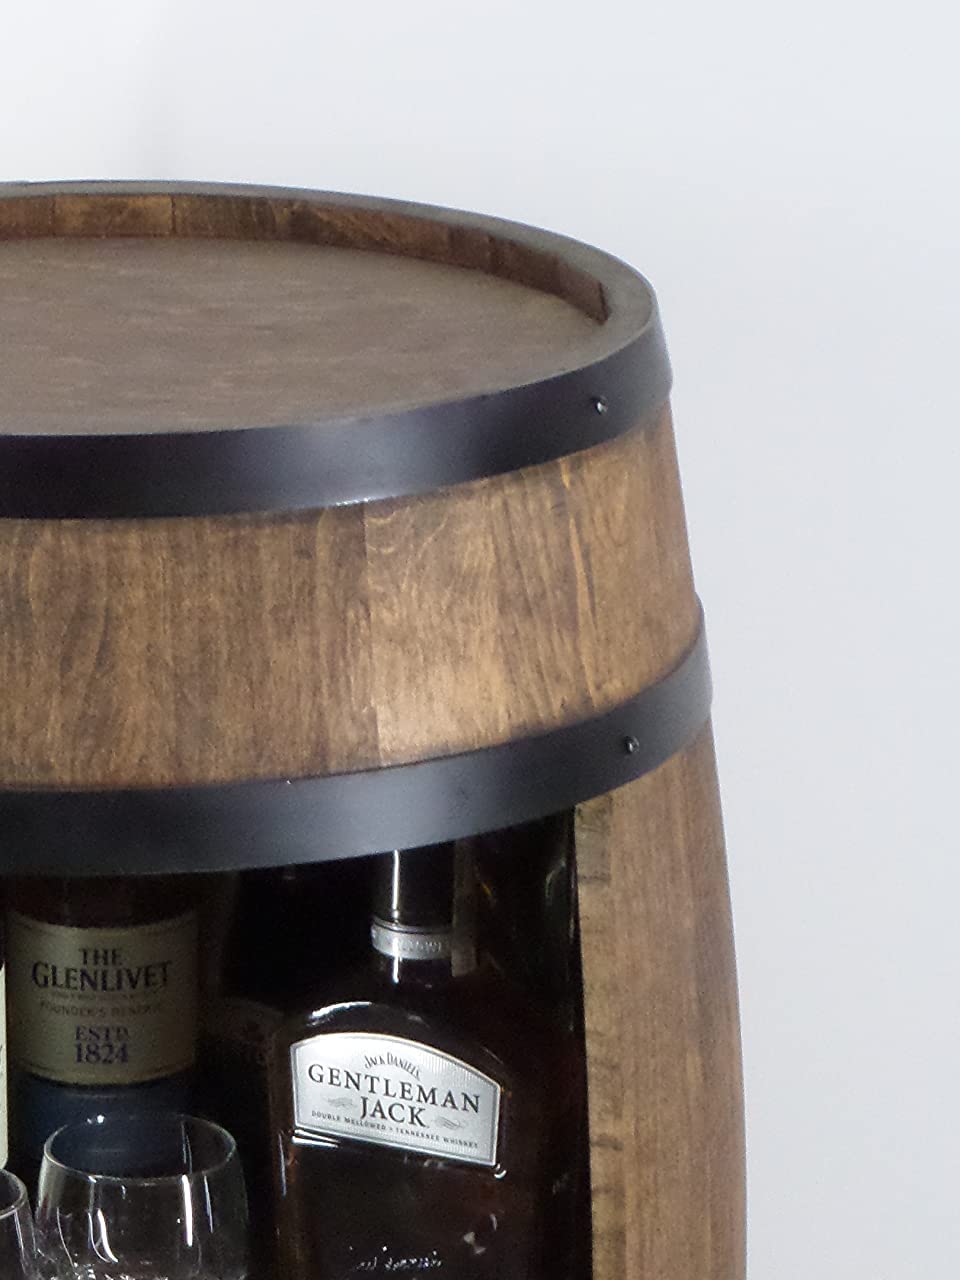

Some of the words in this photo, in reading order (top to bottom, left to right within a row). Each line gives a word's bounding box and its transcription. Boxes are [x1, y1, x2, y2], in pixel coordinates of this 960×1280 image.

[78, 948, 123, 966] THE
[30, 959, 173, 992] GLENLIVET
[75, 1042, 130, 1064] 1824
[307, 1063, 480, 1114] GENTLEMAN
[359, 1095, 427, 1128] JACK
[311, 1109, 341, 1122] DOUBLE
[344, 1115, 387, 1131] MELLOWED
[395, 1126, 440, 1141] TENNESSEE
[442, 1135, 479, 1149] WHISKEY
